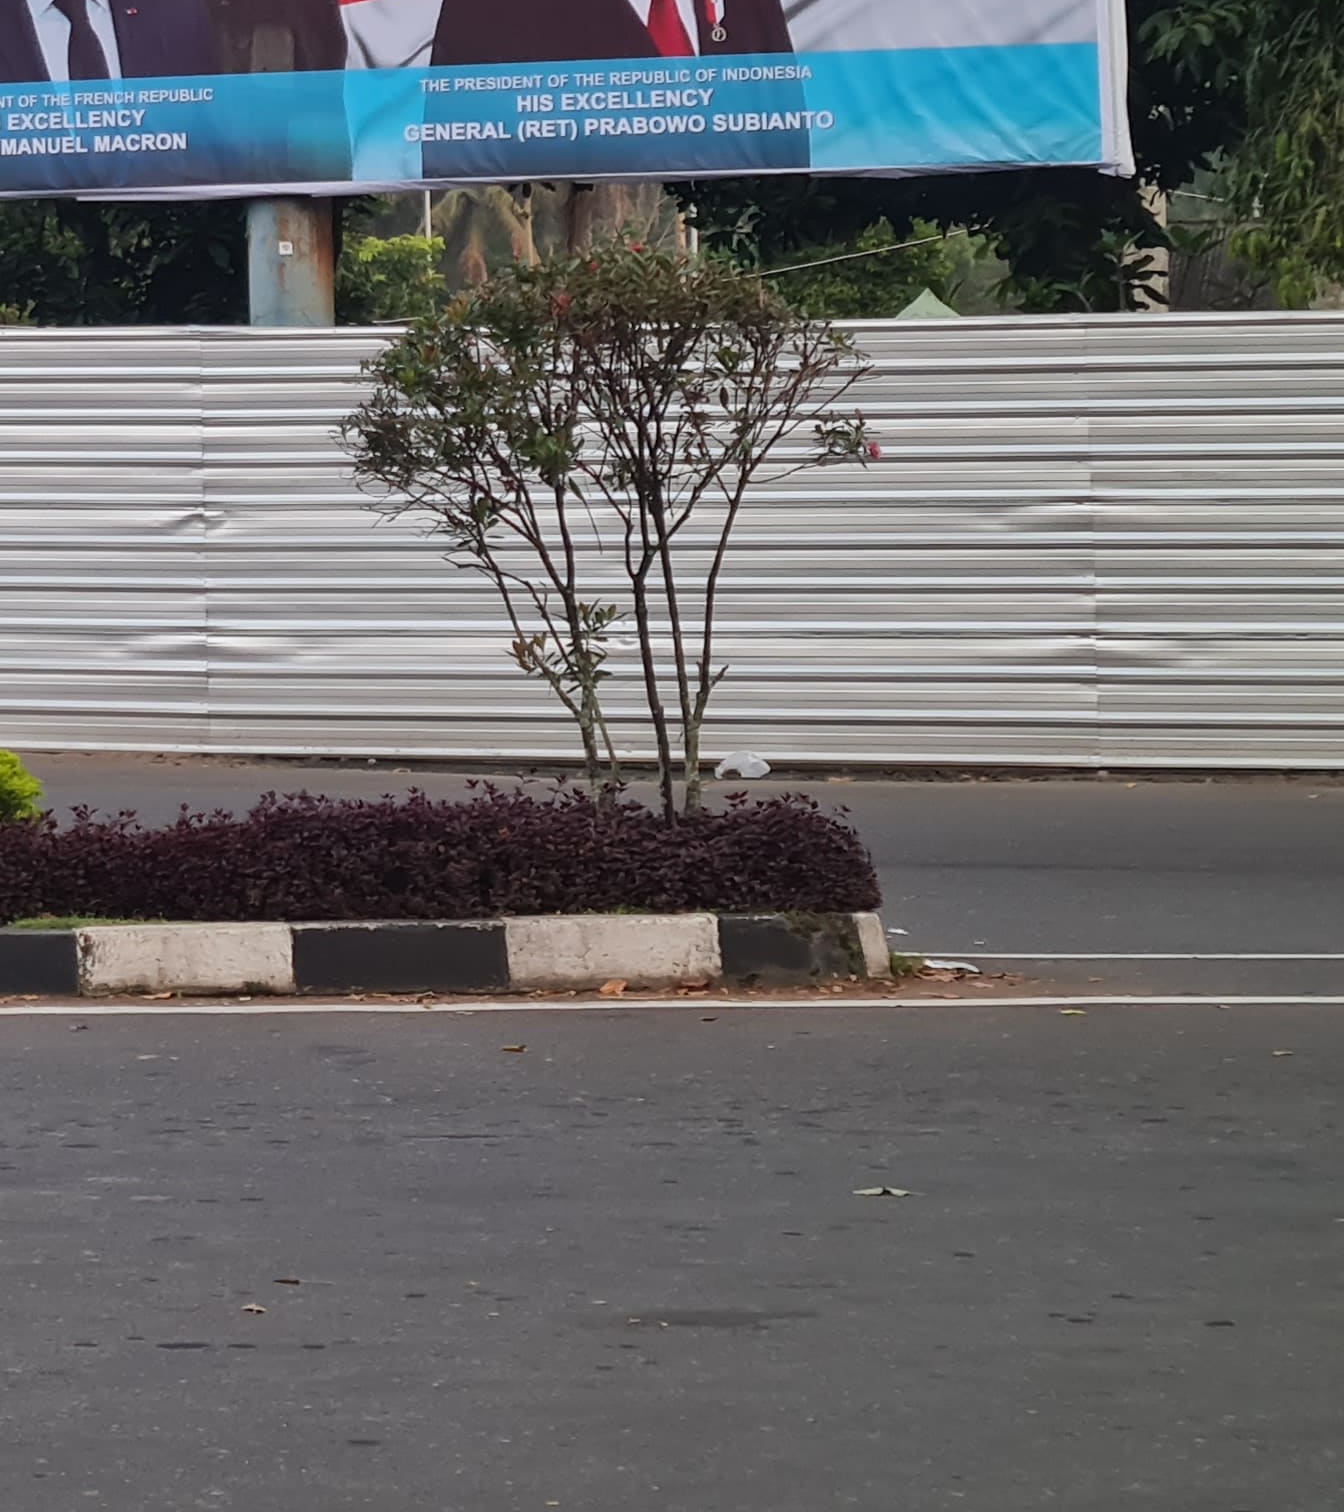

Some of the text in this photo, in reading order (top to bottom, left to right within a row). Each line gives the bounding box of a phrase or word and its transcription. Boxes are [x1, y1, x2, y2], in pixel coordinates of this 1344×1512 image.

[420, 65, 812, 93] THE PRESIDENT OF THE REPUBLIC OF INDONESIA
[18, 94, 37, 108] OF
[42, 93, 71, 107] THE
[74, 91, 134, 106] FRENCH
[139, 88, 213, 104] REPUBLIC
[517, 88, 714, 113] HIS EXCELLENCY
[7, 109, 145, 131] EXCELLENCY
[404, 110, 834, 142] GENERAL (RET) PRABOWO SUBIANTO
[94, 133, 187, 154] MACRON
